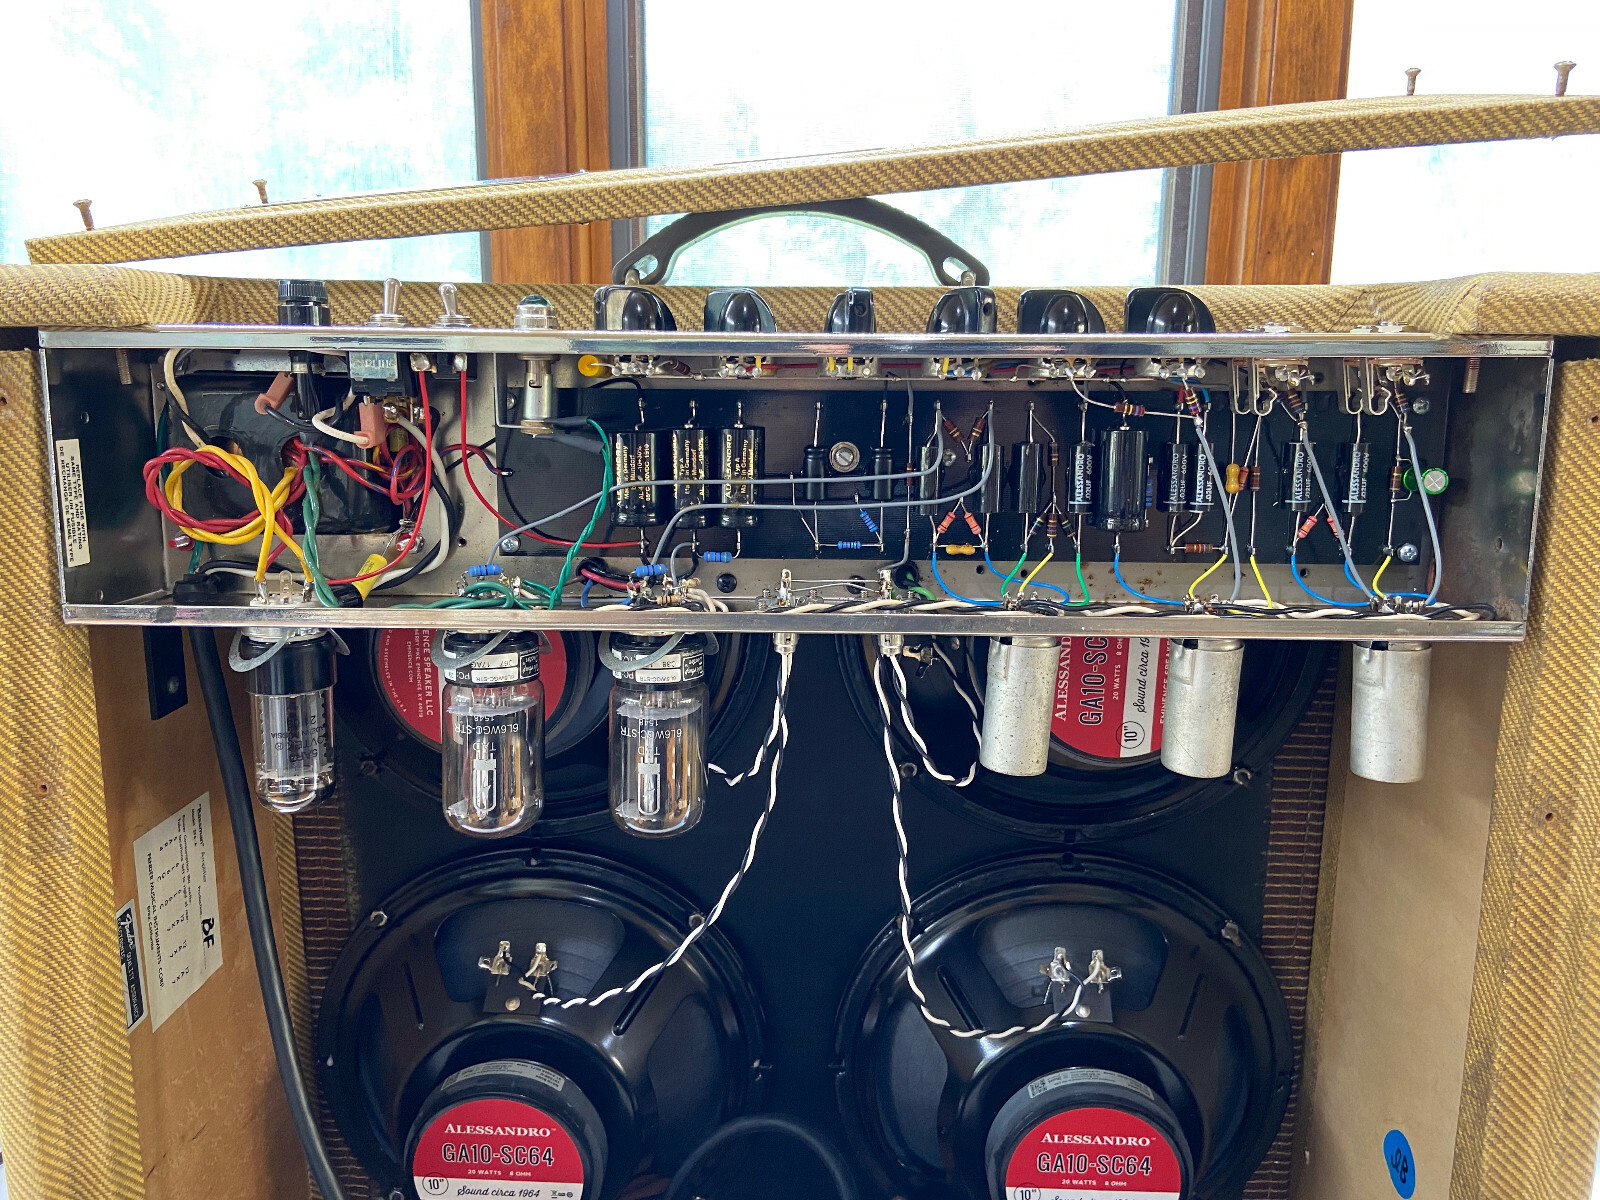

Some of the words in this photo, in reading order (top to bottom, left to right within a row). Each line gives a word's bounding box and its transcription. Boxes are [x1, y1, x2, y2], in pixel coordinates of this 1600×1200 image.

[60, 447, 64, 456] DE
[65, 505, 70, 515] DE
[1077, 454, 1085, 502] ALESSANDRO
[1170, 453, 1179, 503] ALESSANDRO
[1197, 454, 1206, 503] ALESSANDRO
[1295, 452, 1304, 501] ALESSANDRO
[1352, 451, 1361, 501] ALESSANDRO
[69, 500, 74, 509] UN
[1138, 651, 1149, 676] circa
[424, 657, 432, 696] SPEAKER
[1078, 637, 1108, 725] GA10-SC
[1113, 692, 1118, 700] 20
[1132, 678, 1146, 713] Sound
[454, 723, 518, 734] 6L6WGC-STR
[620, 727, 682, 739] 6L6WGC-STR
[1123, 726, 1137, 742] 10"
[473, 742, 496, 751] TAD
[149, 882, 158, 913] MUSICAL
[153, 915, 162, 965] INSTRUMENTS
[126, 952, 135, 981] QUALITY
[130, 984, 139, 1021] ASSURANCE
[445, 1123, 551, 1137] ALESSANDRO
[1041, 1132, 1150, 1146] ALESSANDRO
[442, 1142, 554, 1166] GA10-SC64
[1037, 1152, 1152, 1176] GA10-SC64
[428, 1178, 444, 1190] 10"
[457, 1185, 489, 1197] Sound
[491, 1189, 516, 1197] circa
[518, 1189, 540, 1198] 1964
[1020, 1188, 1037, 1200] 10"
